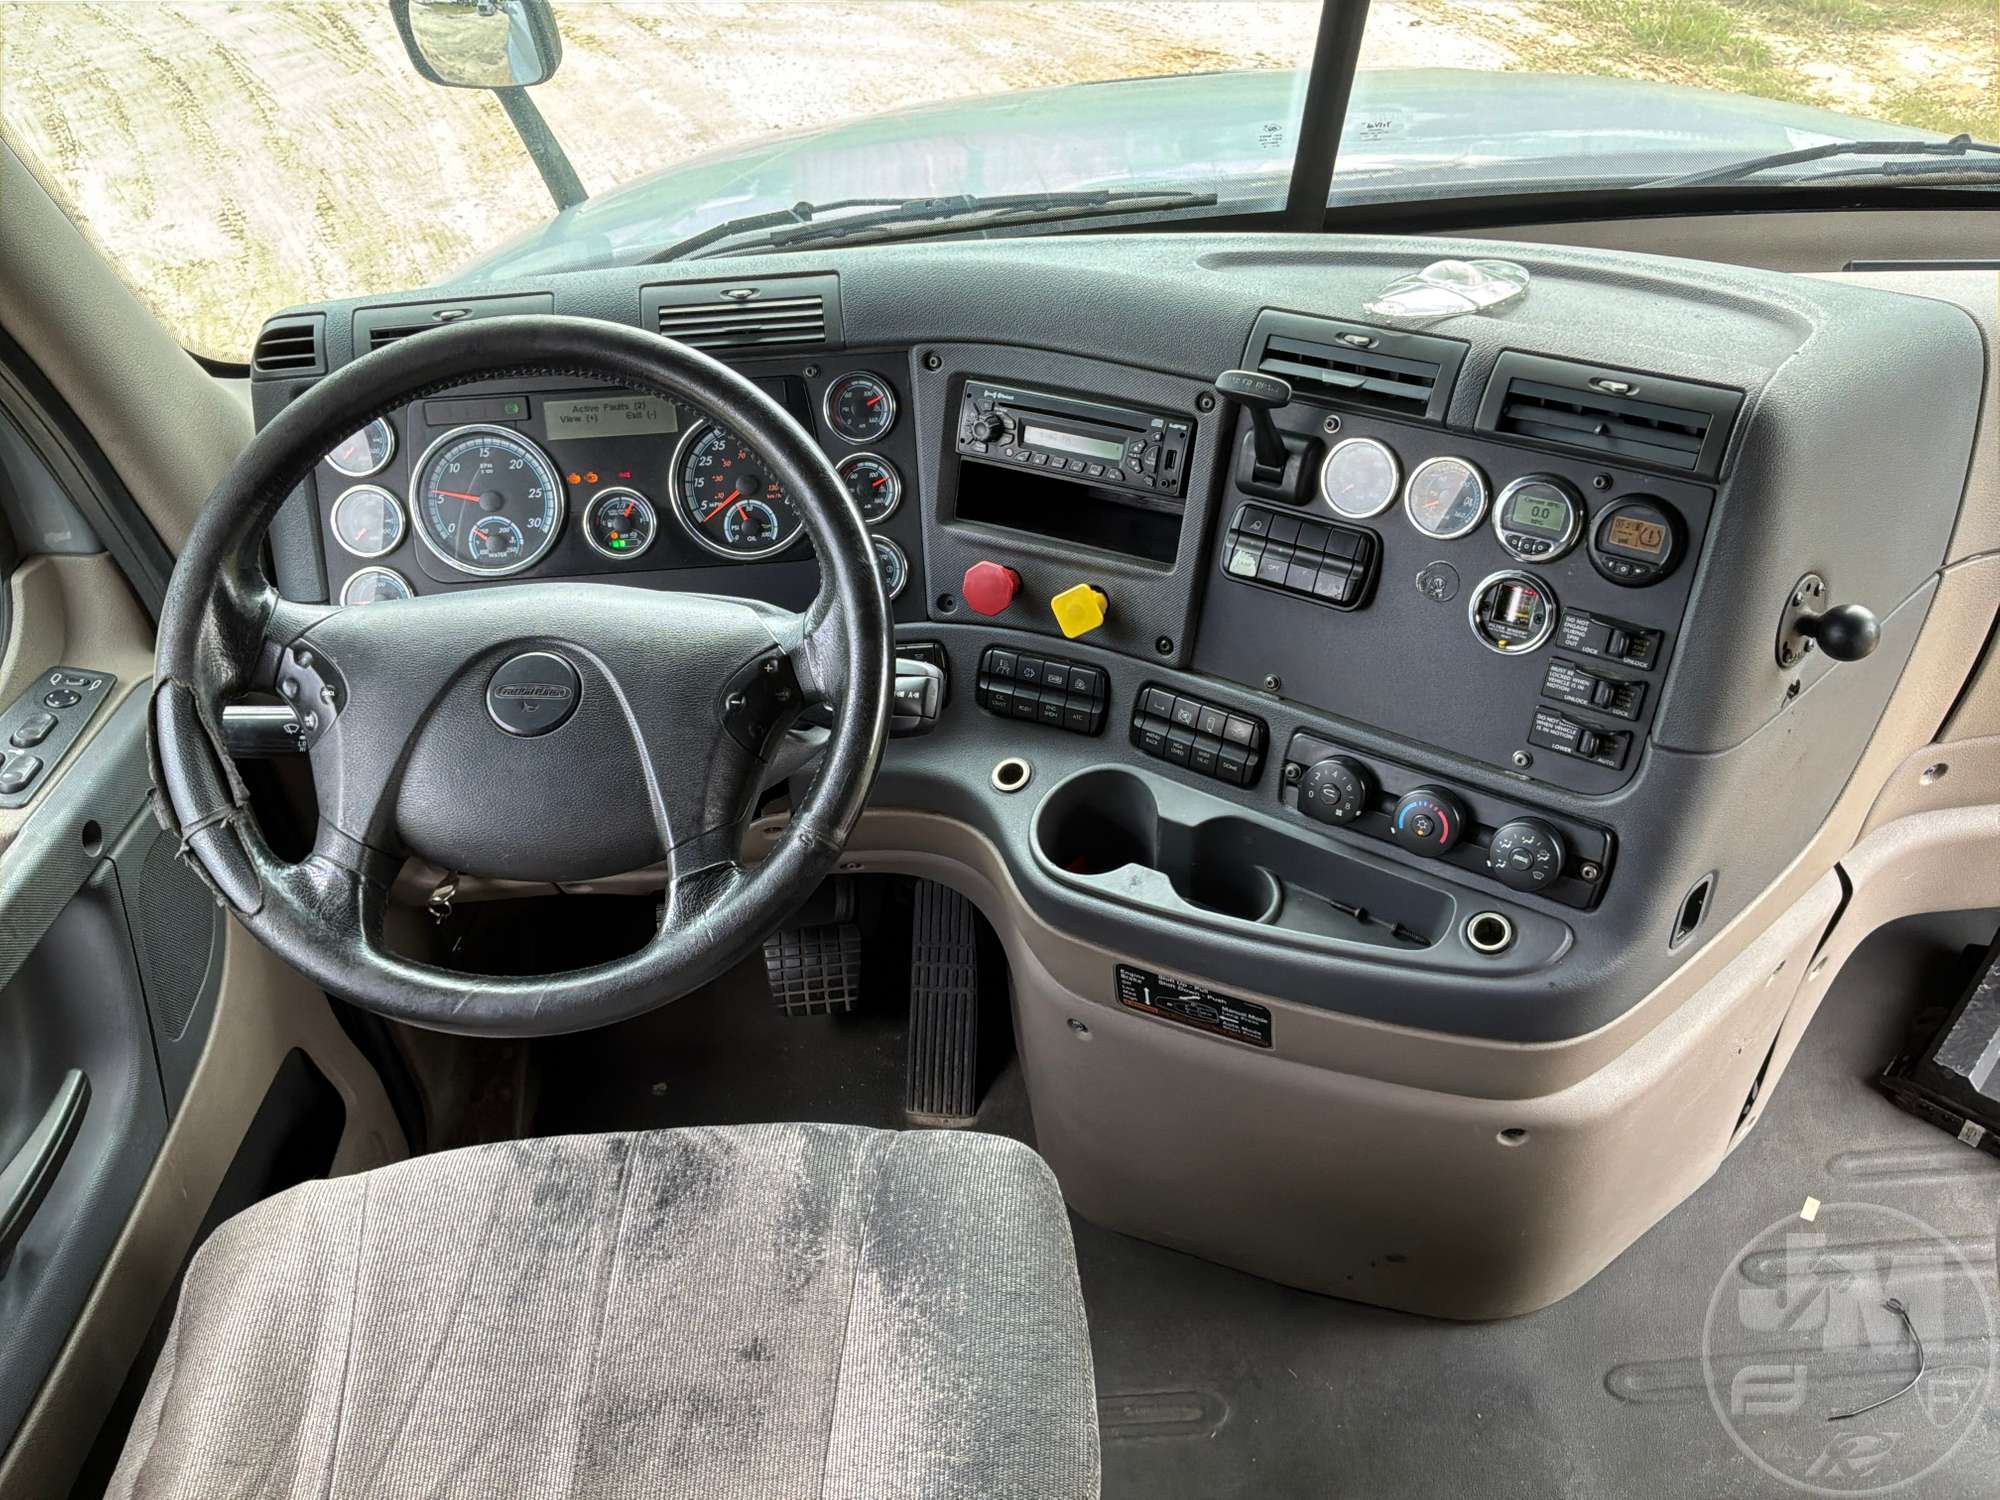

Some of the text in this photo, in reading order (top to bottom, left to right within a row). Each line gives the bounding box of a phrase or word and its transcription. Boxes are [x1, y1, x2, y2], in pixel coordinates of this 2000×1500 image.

[572, 405, 599, 413] Active
[603, 402, 629, 412] Faults
[560, 416, 582, 424] View
[625, 411, 643, 420] Exit
[712, 441, 726, 451] 35
[480, 447, 490, 457] 15
[509, 460, 523, 470] 20
[699, 456, 713, 466] 25
[449, 463, 460, 473] 10
[694, 478, 705, 487] 15
[528, 488, 542, 498] 25
[437, 495, 444, 504] 5
[701, 500, 708, 510] 5
[1531, 506, 1550, 519] 0.0
[448, 523, 455, 533] 0
[527, 518, 541, 528] 30
[1564, 622, 1588, 632] ENGAGE
[1563, 628, 1586, 638] DURING
[1582, 646, 1599, 655] LOCK
[1623, 657, 1648, 668] UNLOCK
[1551, 665, 1566, 673] MUST
[1548, 677, 1569, 686] VEHICLE
[1549, 671, 1590, 686] LOCKED WHEN
[1546, 682, 1570, 692] MOTION
[1564, 694, 1588, 705] UNLOCK
[1612, 708, 1629, 717] LOCK
[1547, 716, 1560, 724] NOT
[1536, 720, 1553, 729] WHEN
[1554, 724, 1577, 735] VEHICLE
[1550, 729, 1574, 740] MOTION
[1552, 743, 1571, 753] LOWER
[1223, 762, 1238, 771] DOME
[1597, 758, 1615, 766] AUTO
[1314, 772, 1321, 780] 2
[1332, 770, 1338, 778] 4
[1308, 790, 1314, 798] 0
[1120, 969, 1145, 980] Engine
[1120, 974, 1142, 983] Brake
[1177, 985, 1200, 996] Down
[1207, 995, 1227, 1004] Push
[1221, 1006, 1268, 1023] Manual Mode
[1241, 1027, 1261, 1035] Mode
